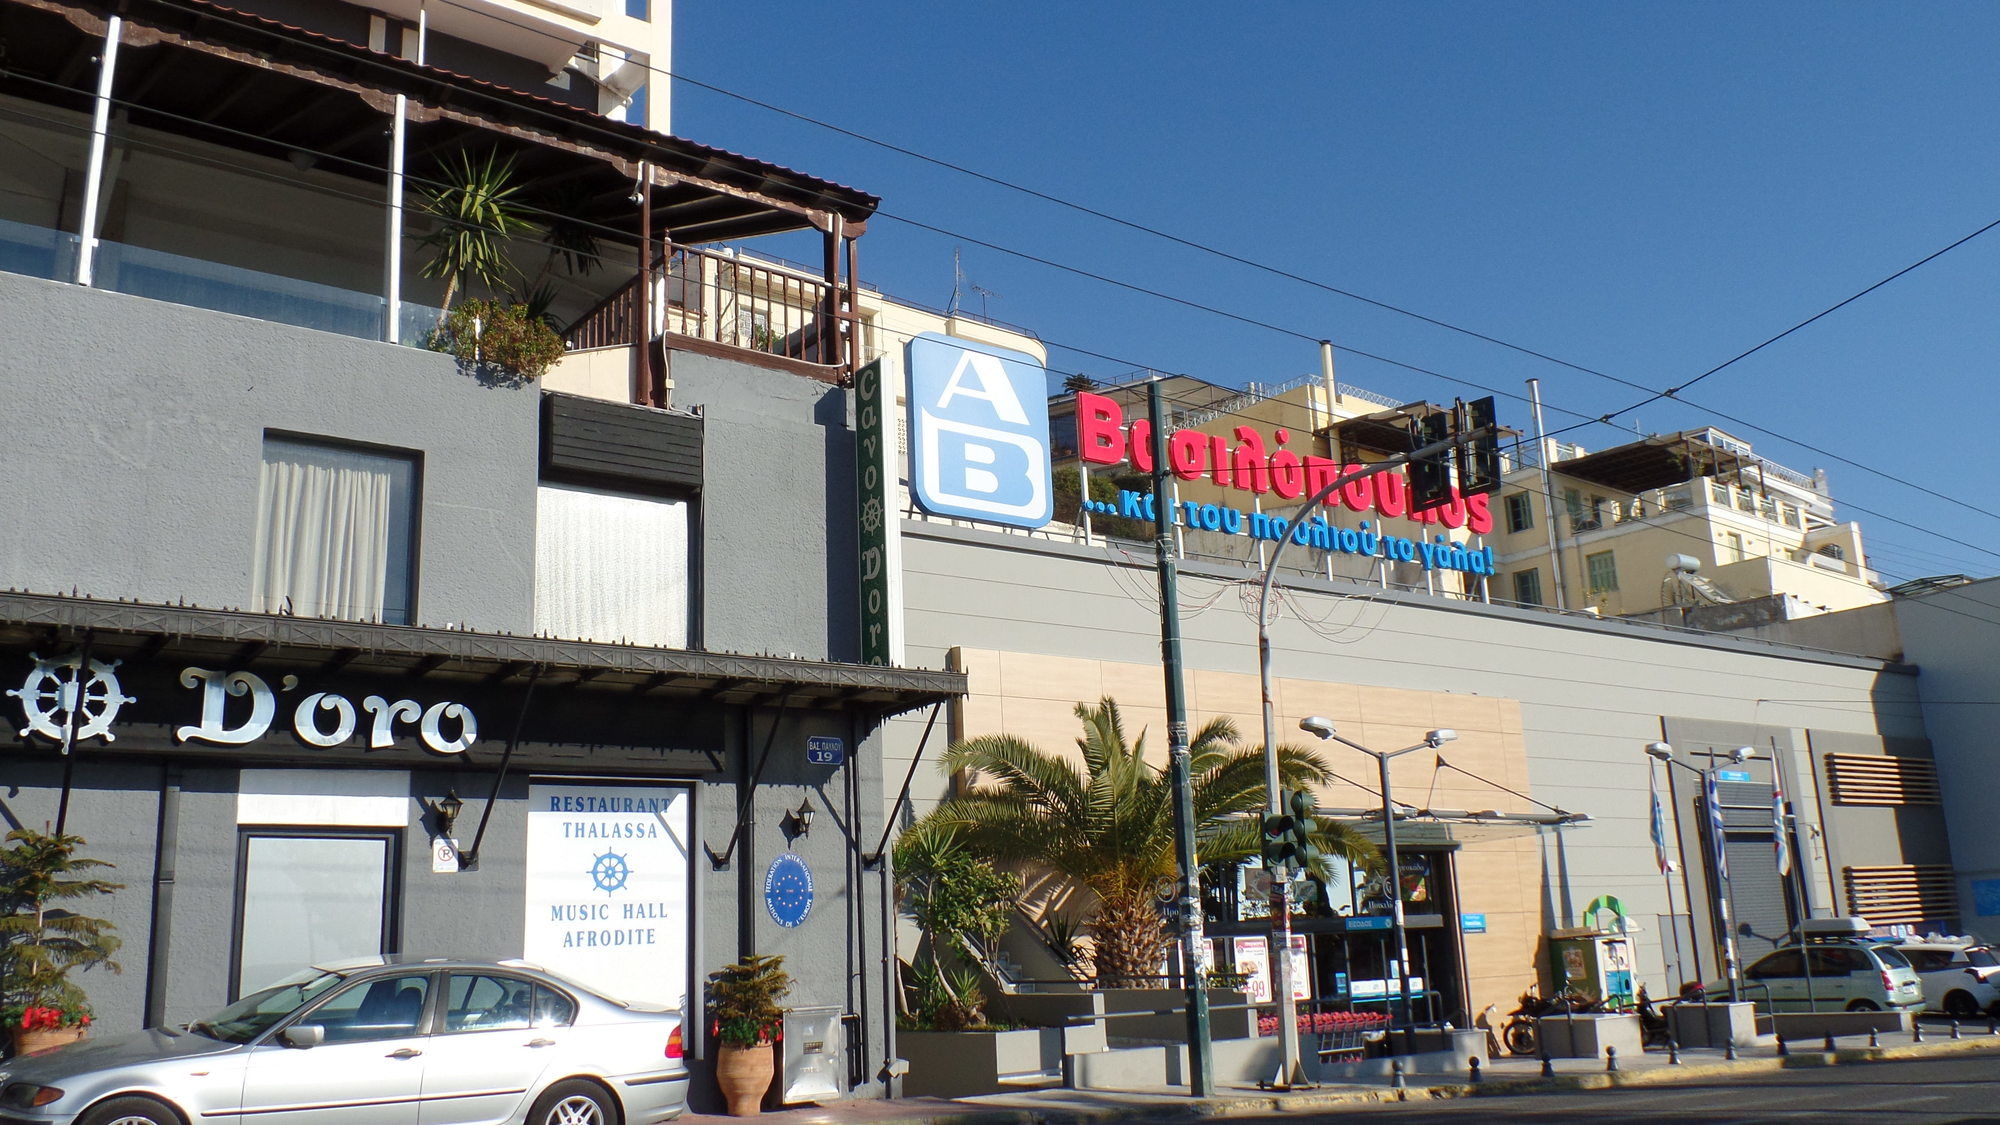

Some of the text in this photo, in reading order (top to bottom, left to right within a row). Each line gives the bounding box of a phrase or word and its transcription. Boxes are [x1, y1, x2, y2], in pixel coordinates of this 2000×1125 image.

[859, 368, 877, 490] Cavo
[1182, 501, 1242, 535] του
[1382, 535, 1415, 562] το
[1416, 533, 1496, 577] γάλα!
[177, 666, 477, 753] D'oro
[816, 751, 833, 762] 19
[550, 796, 671, 813] RESTAURANT
[563, 822, 658, 838] THALASSA
[551, 903, 668, 921] MUSIC HALL
[766, 897, 784, 925] MAISONS
[563, 928, 656, 948] AFRODITE
